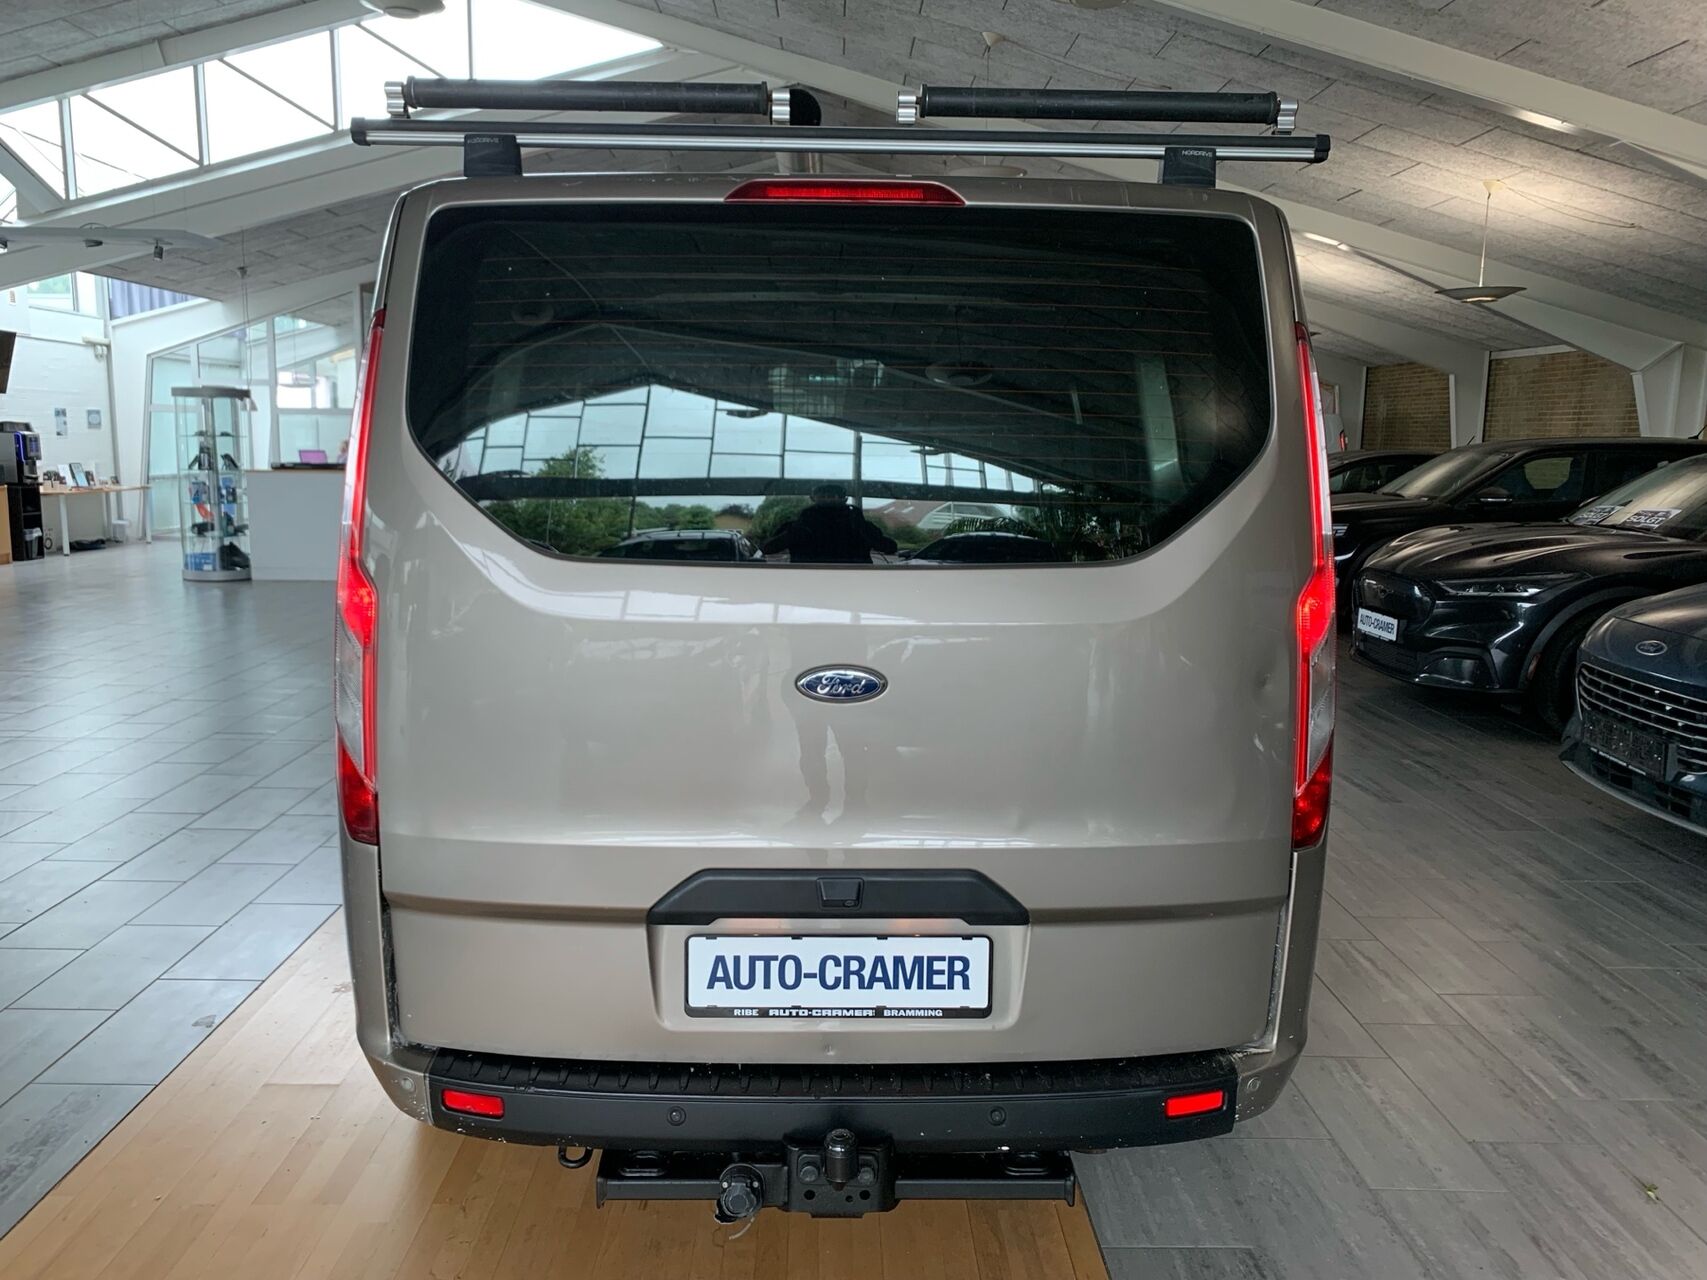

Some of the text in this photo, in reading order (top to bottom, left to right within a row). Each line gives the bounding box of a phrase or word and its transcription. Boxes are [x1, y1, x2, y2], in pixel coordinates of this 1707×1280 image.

[1626, 515, 1666, 525] SOLGT
[1360, 613, 1395, 635] AUTO-CRAMER
[816, 673, 866, 694] Ford
[706, 954, 971, 991] AUTO-CRAMER
[733, 1008, 760, 1016] RIBE
[883, 1009, 943, 1017] BRAMMING
